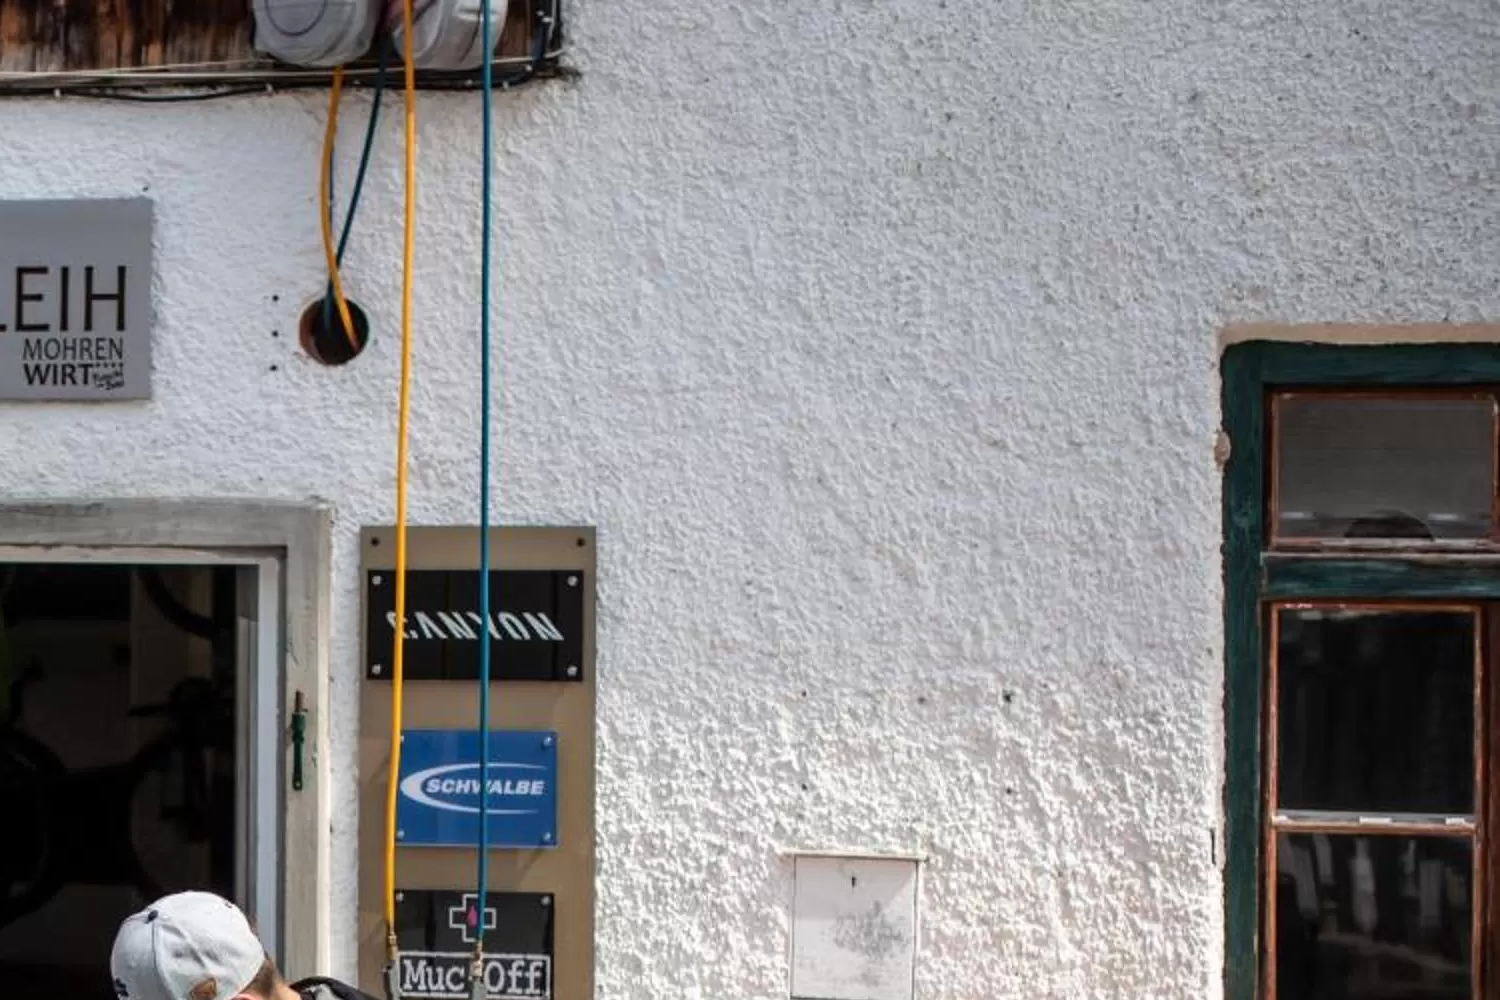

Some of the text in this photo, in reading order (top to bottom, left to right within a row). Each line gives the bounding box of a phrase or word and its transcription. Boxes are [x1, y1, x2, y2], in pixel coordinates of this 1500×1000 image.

[22, 337, 124, 361] MOHREN
[22, 363, 94, 386] WIRT
[402, 959, 544, 994] MucOff
